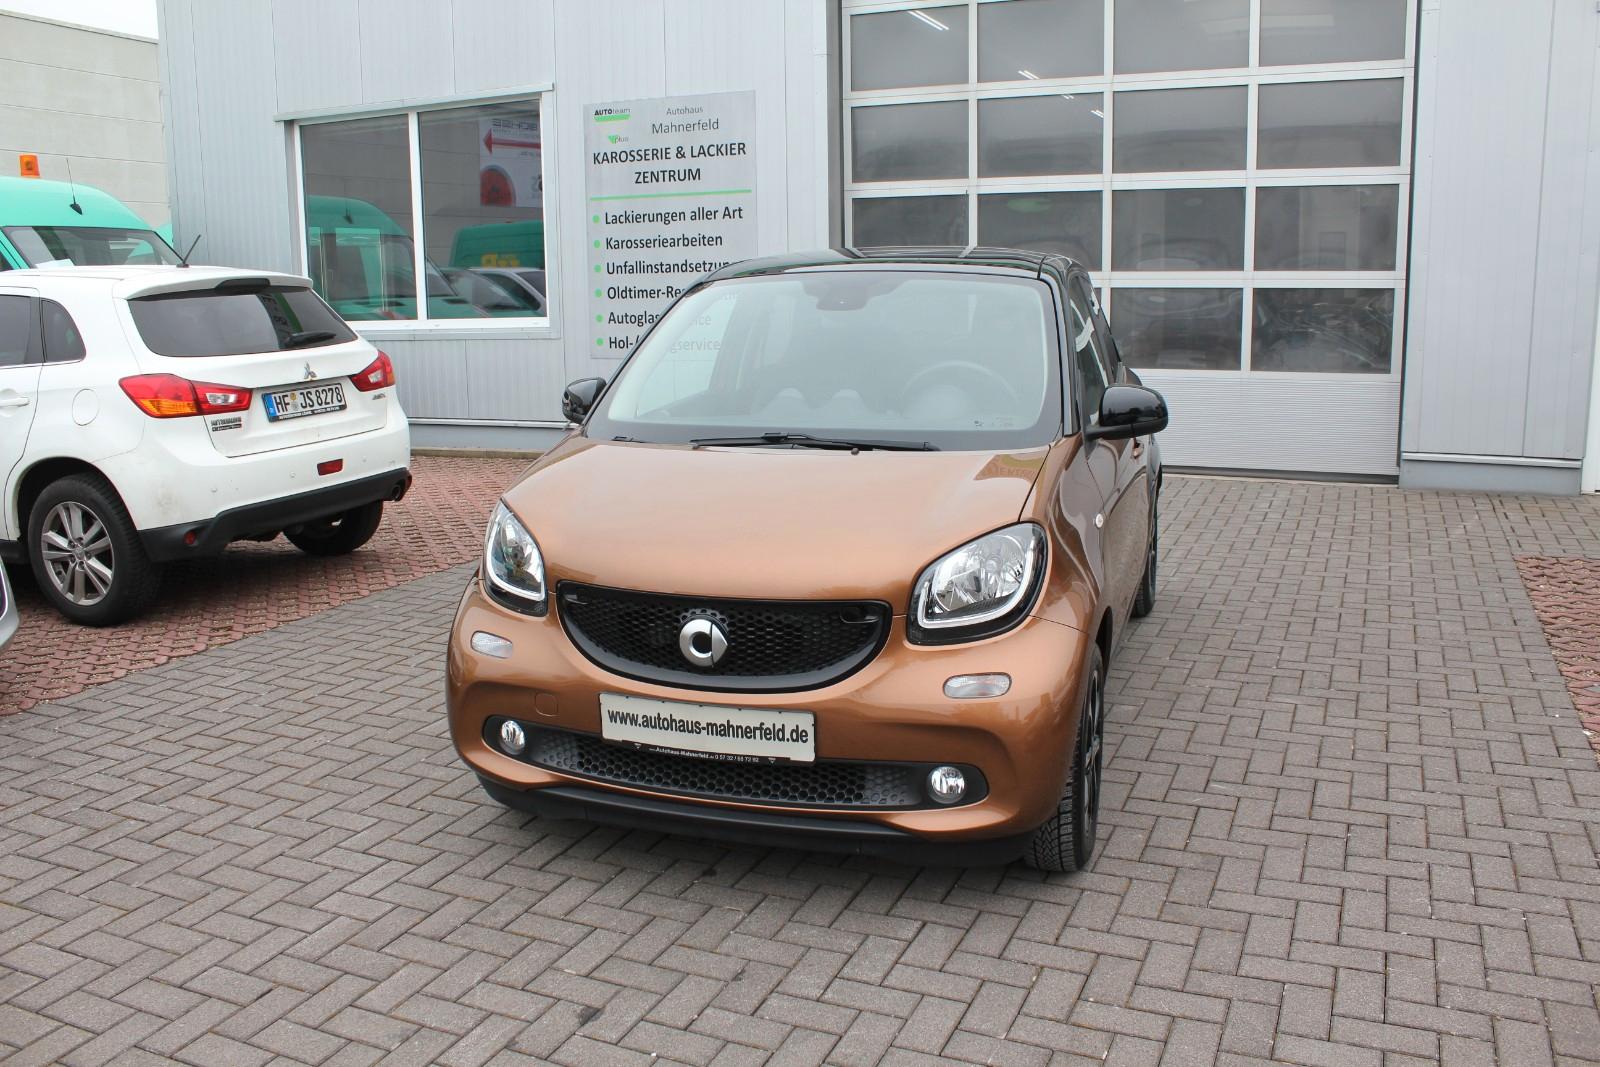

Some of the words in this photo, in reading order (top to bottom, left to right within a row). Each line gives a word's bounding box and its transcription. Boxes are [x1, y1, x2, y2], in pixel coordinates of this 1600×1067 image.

[666, 105, 704, 116] Autohaus
[651, 118, 720, 134] Mahnerfeld
[593, 147, 671, 165] KAROSSERIE
[675, 145, 686, 159] &
[690, 142, 747, 158] LACKIER
[634, 168, 701, 184] ZENTRUM
[605, 210, 686, 225] Lackierungen
[690, 207, 719, 221] aller
[722, 206, 743, 219] Art
[606, 233, 723, 250] Karosseriearbeiten
[274, 394, 290, 413] HF
[300, 390, 315, 409] JS
[315, 386, 343, 407] 8278
[607, 709, 809, 743] www.autohaus-mahnerfeld.de
